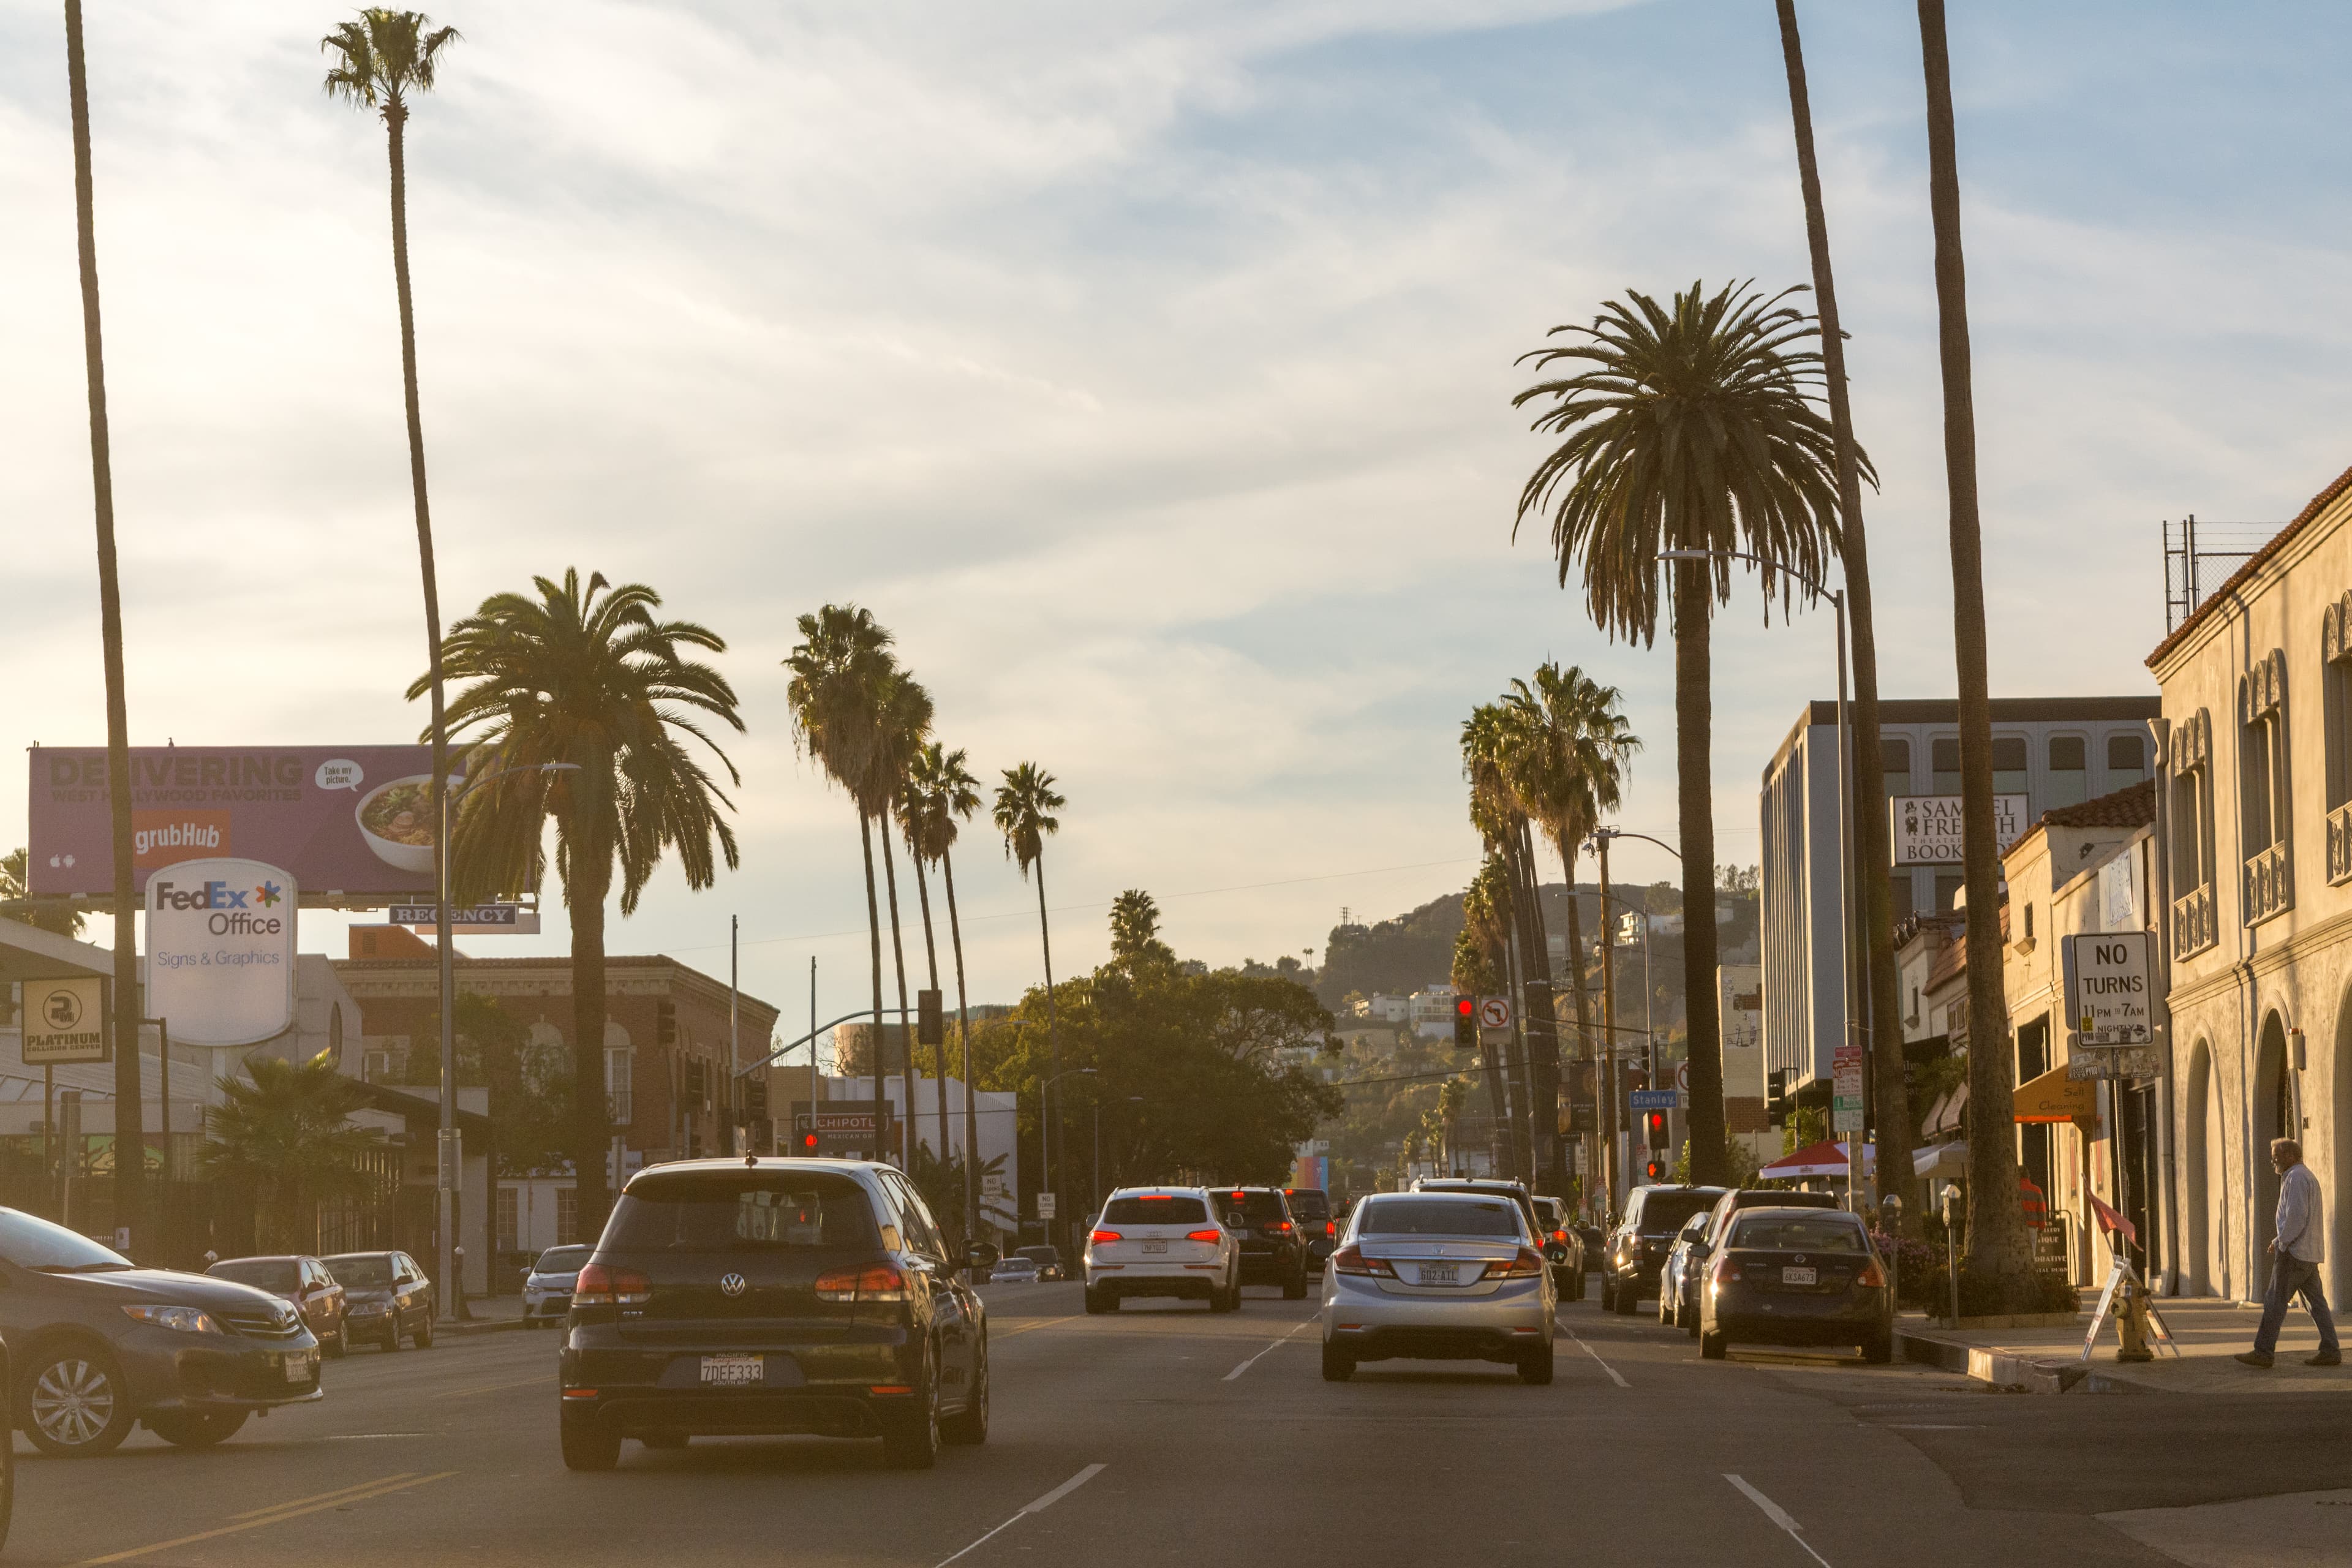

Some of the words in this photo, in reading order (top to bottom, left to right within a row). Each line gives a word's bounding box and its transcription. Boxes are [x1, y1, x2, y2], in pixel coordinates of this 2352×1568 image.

[51, 756, 303, 787] DEIVERING
[325, 766, 340, 775] Take
[342, 766, 352, 775] my
[326, 775, 351, 785] picture.
[51, 790, 97, 802] WEST
[102, 790, 209, 802] HLYWOOD
[214, 789, 301, 802] FAVORITES
[1922, 799, 2015, 818] SAMEL
[1923, 816, 2016, 835] FREH
[135, 823, 220, 854] grubHub
[156, 881, 249, 910] FedEx
[396, 908, 510, 922] REENCY
[208, 912, 281, 935] Office
[157, 951, 197, 969] Signs
[200, 952, 211, 966] &
[216, 950, 279, 967] Graphics
[2095, 943, 2127, 965] NO
[2082, 975, 2143, 995] TURNS
[2097, 1023, 2135, 1033] NIGHTLY
[26, 1033, 100, 1047] PLATINUM
[1903, 1060, 1921, 1071] ilm
[1833, 1068, 1842, 1078] NO
[2064, 1087, 2084, 1097] Sell
[1633, 1095, 1673, 1105] Stanley
[2038, 1100, 2085, 1112] Cleaning
[817, 1117, 876, 1128] CHIPOTL
[1785, 1272, 1814, 1281] 6KSA673
[703, 1364, 761, 1381] 7DEF333
